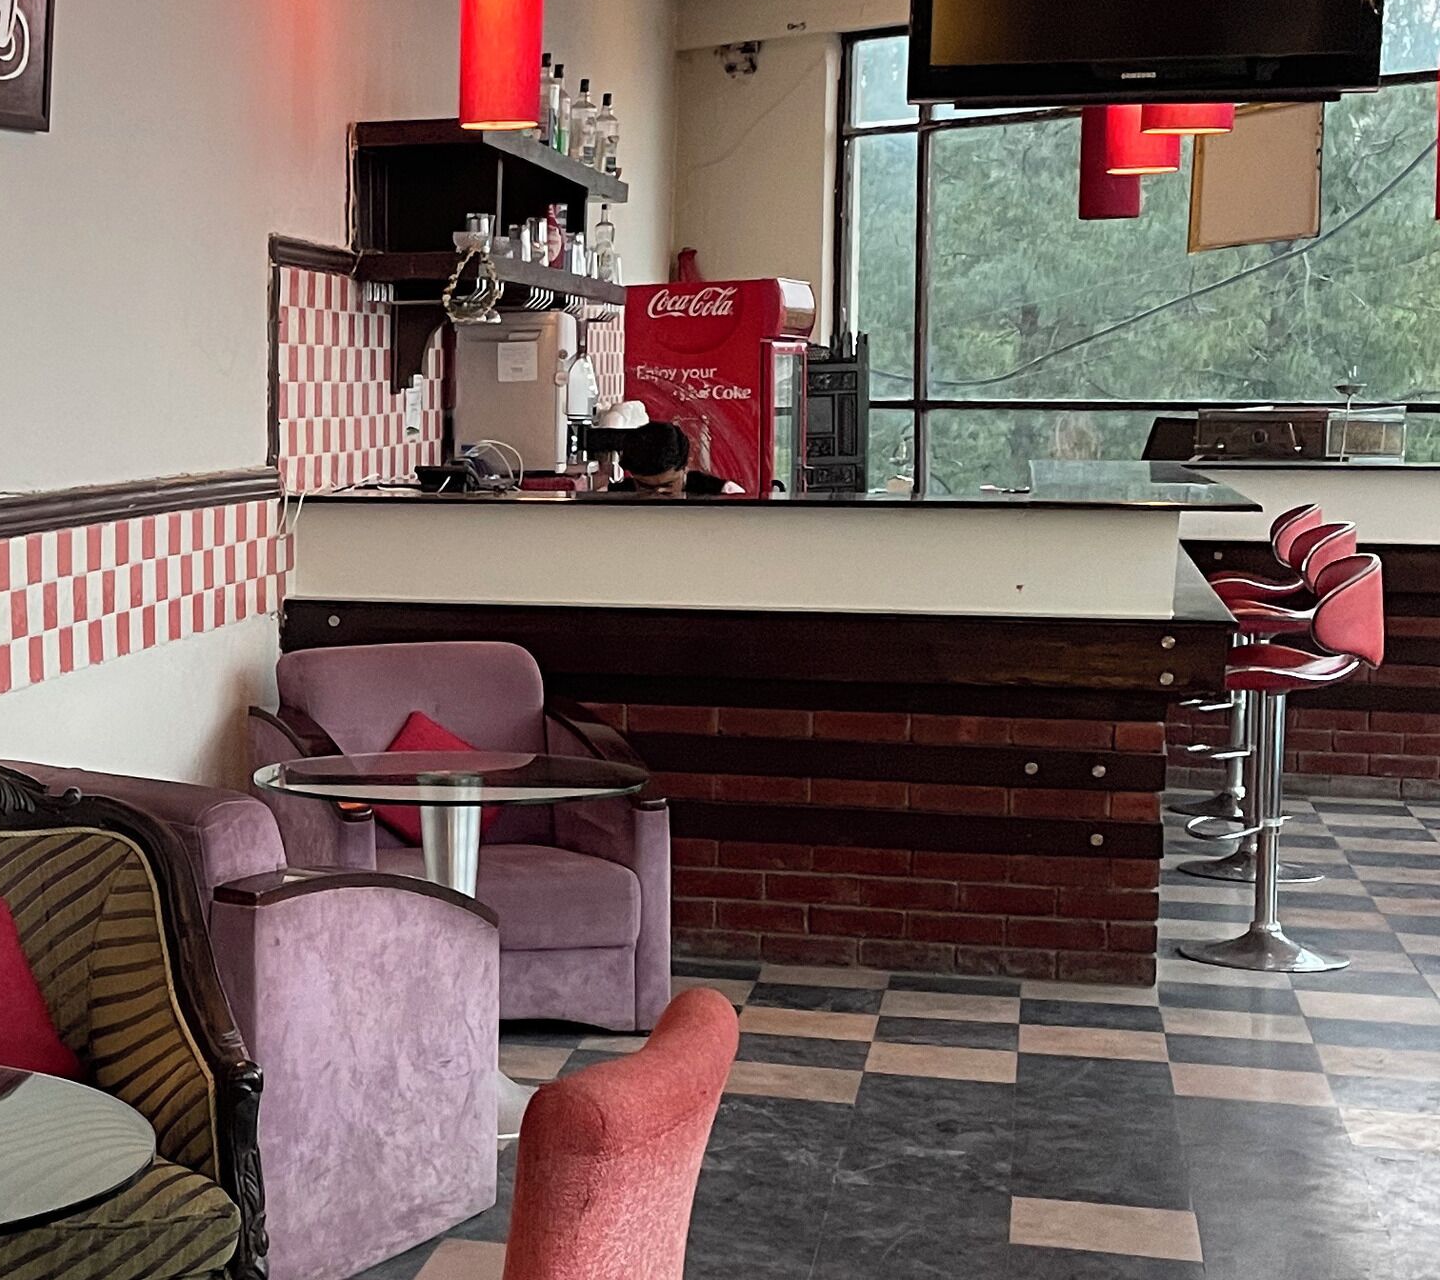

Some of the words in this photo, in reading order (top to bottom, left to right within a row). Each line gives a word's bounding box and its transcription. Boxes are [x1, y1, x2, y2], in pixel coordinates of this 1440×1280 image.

[647, 287, 738, 318] Coca-Cola
[636, 365, 676, 382] Enjoy
[681, 367, 717, 384] your
[712, 385, 751, 399] Coke
